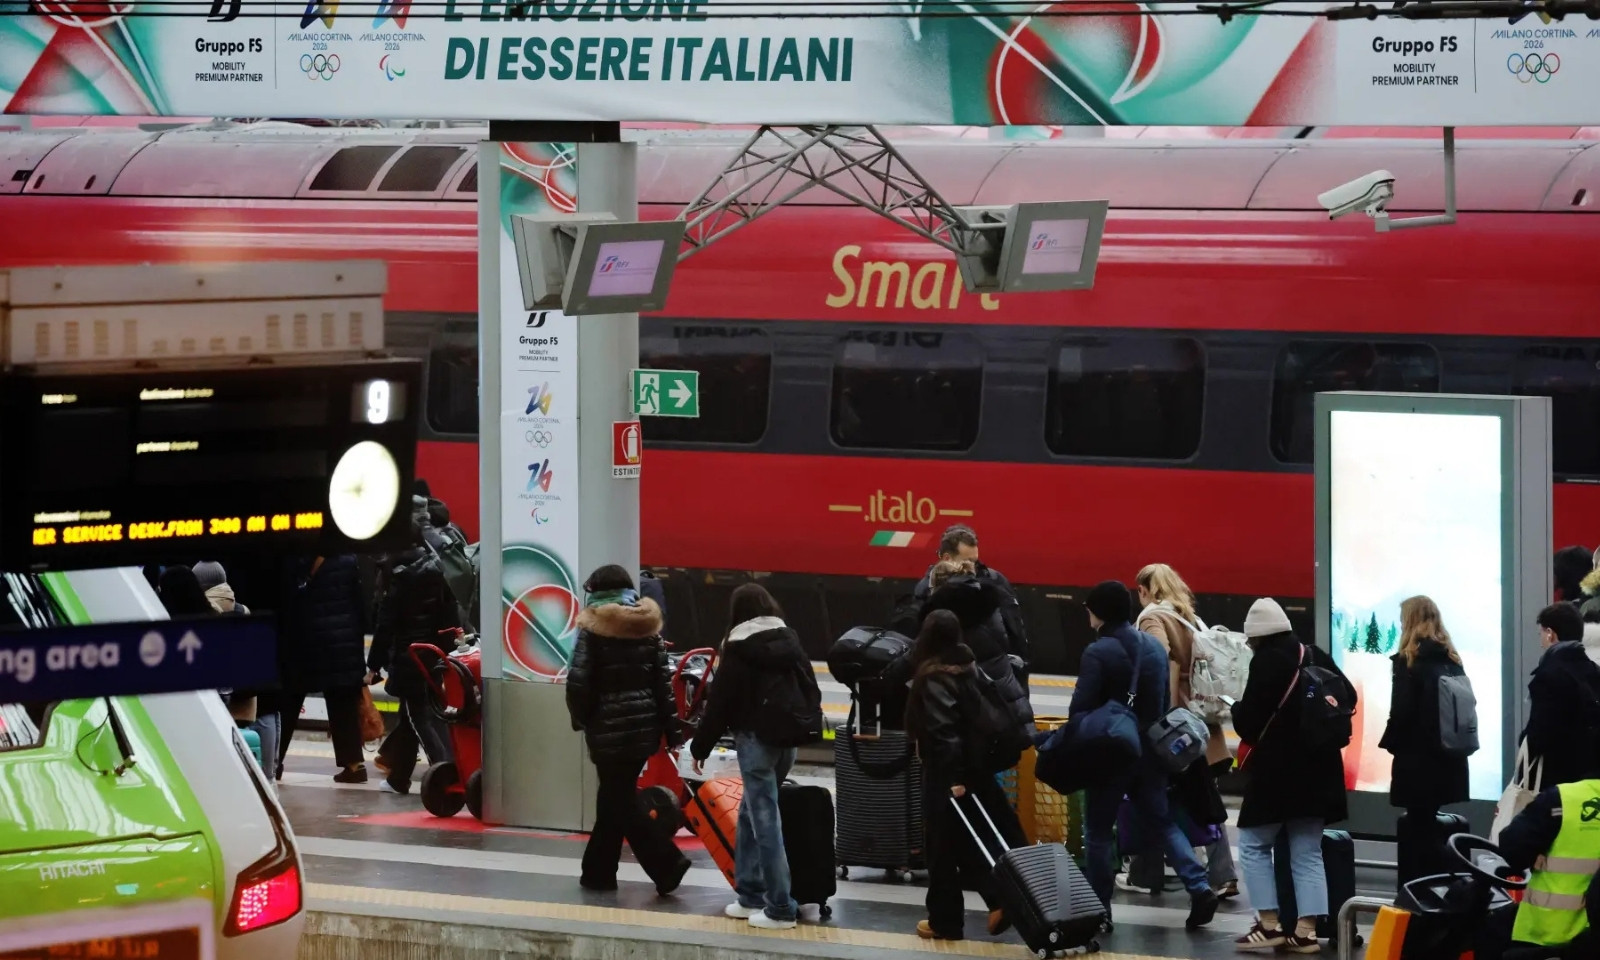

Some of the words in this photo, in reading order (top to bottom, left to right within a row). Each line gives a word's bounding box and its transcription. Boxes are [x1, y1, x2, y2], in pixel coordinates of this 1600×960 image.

[444, 0, 708, 22] LEMOZIONE
[288, 33, 319, 41] MILANO
[320, 33, 353, 41] CORTINA
[360, 33, 391, 41] MILANO
[392, 33, 426, 41] CORTINA
[1490, 30, 1533, 39] MILANO
[1534, 29, 1577, 38] CORTINA
[195, 37, 245, 56] Gruppo
[248, 37, 263, 53] FS
[312, 42, 328, 51] 2026
[384, 42, 400, 51] 2026
[1372, 36, 1434, 56] Gruppo
[1440, 36, 1458, 53] FS
[1523, 40, 1544, 49] 2026
[444, 37, 490, 80] DI
[497, 37, 653, 81] ESSERE
[660, 37, 854, 82] ITALIANI
[212, 62, 246, 71] MOBILITY
[1393, 63, 1436, 73] MOBILITY
[195, 73, 229, 82] PREMIUM
[230, 73, 263, 82] PARTNER
[1372, 76, 1415, 86] PREMIUM
[1416, 75, 1459, 85] PARTNER
[825, 244, 1000, 311] Smar
[519, 335, 548, 347] Gruppo
[549, 336, 559, 346] FS
[367, 380, 390, 424] 9
[63, 523, 123, 544] SERVICE
[46, 642, 119, 671] area
[39, 860, 106, 881] HITACHI
